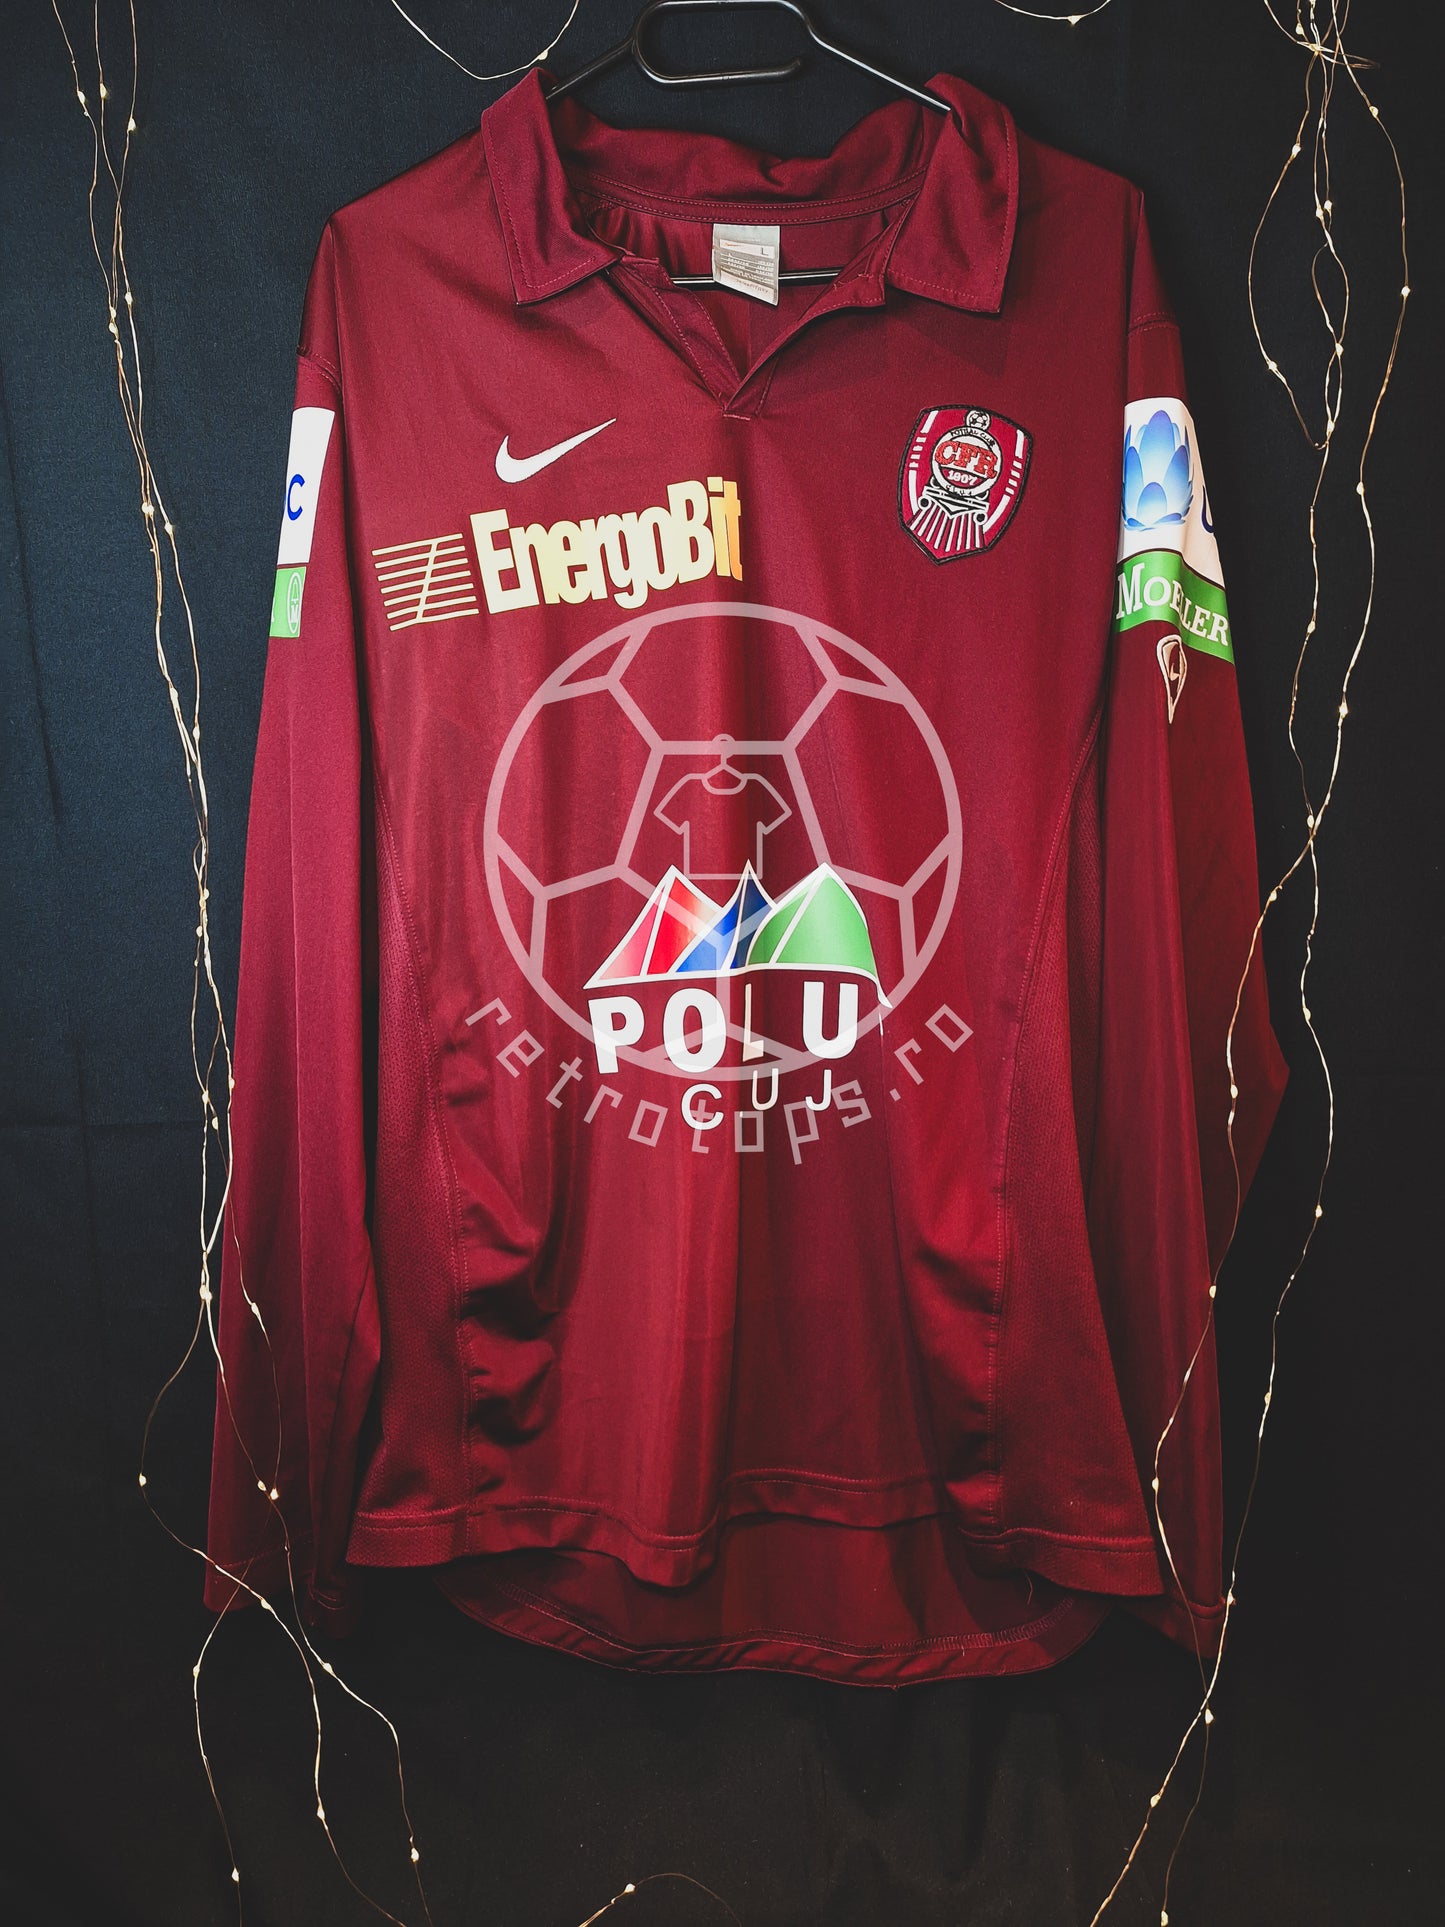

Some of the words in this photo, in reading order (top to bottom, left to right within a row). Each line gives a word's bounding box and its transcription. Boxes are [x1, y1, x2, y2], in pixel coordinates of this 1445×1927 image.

[761, 247, 769, 256] L
[934, 440, 998, 480] CFR
[947, 470, 978, 486] 1907
[469, 476, 743, 615] EnergoBit
